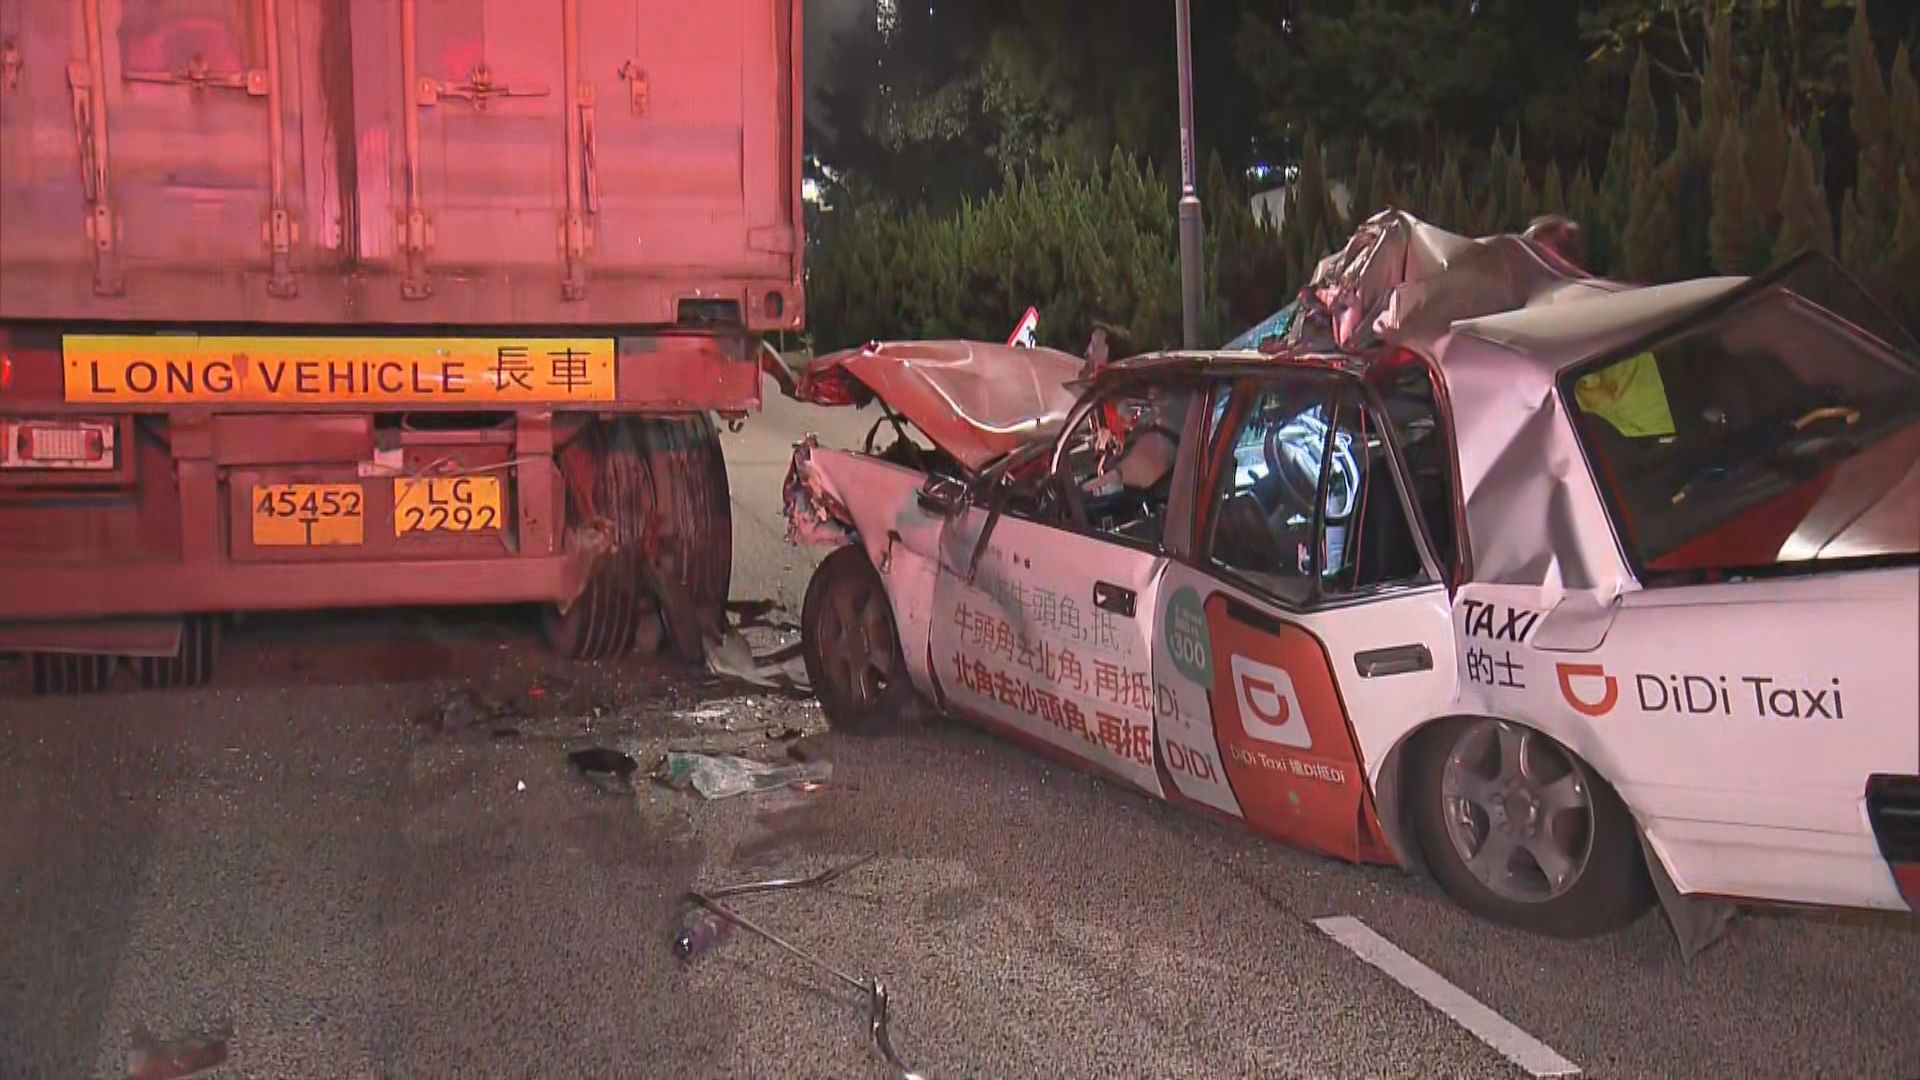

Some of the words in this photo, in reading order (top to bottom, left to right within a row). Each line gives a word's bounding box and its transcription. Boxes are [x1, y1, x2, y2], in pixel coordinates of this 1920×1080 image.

[91, 360, 235, 394] LONG
[258, 360, 466, 394] VEHICLE
[488, 346, 593, 394] 長車
[256, 491, 361, 517] 45452
[428, 480, 473, 506] LG
[298, 518, 319, 544] T
[404, 506, 497, 532] 2292
[1462, 600, 1539, 643] TAXI
[1466, 646, 1526, 690] 的士
[1635, 673, 1732, 716] DiDi
[1741, 676, 1844, 720] Taxi
[1165, 739, 1219, 785] DiDi
[1257, 751, 1288, 772] Taxi
